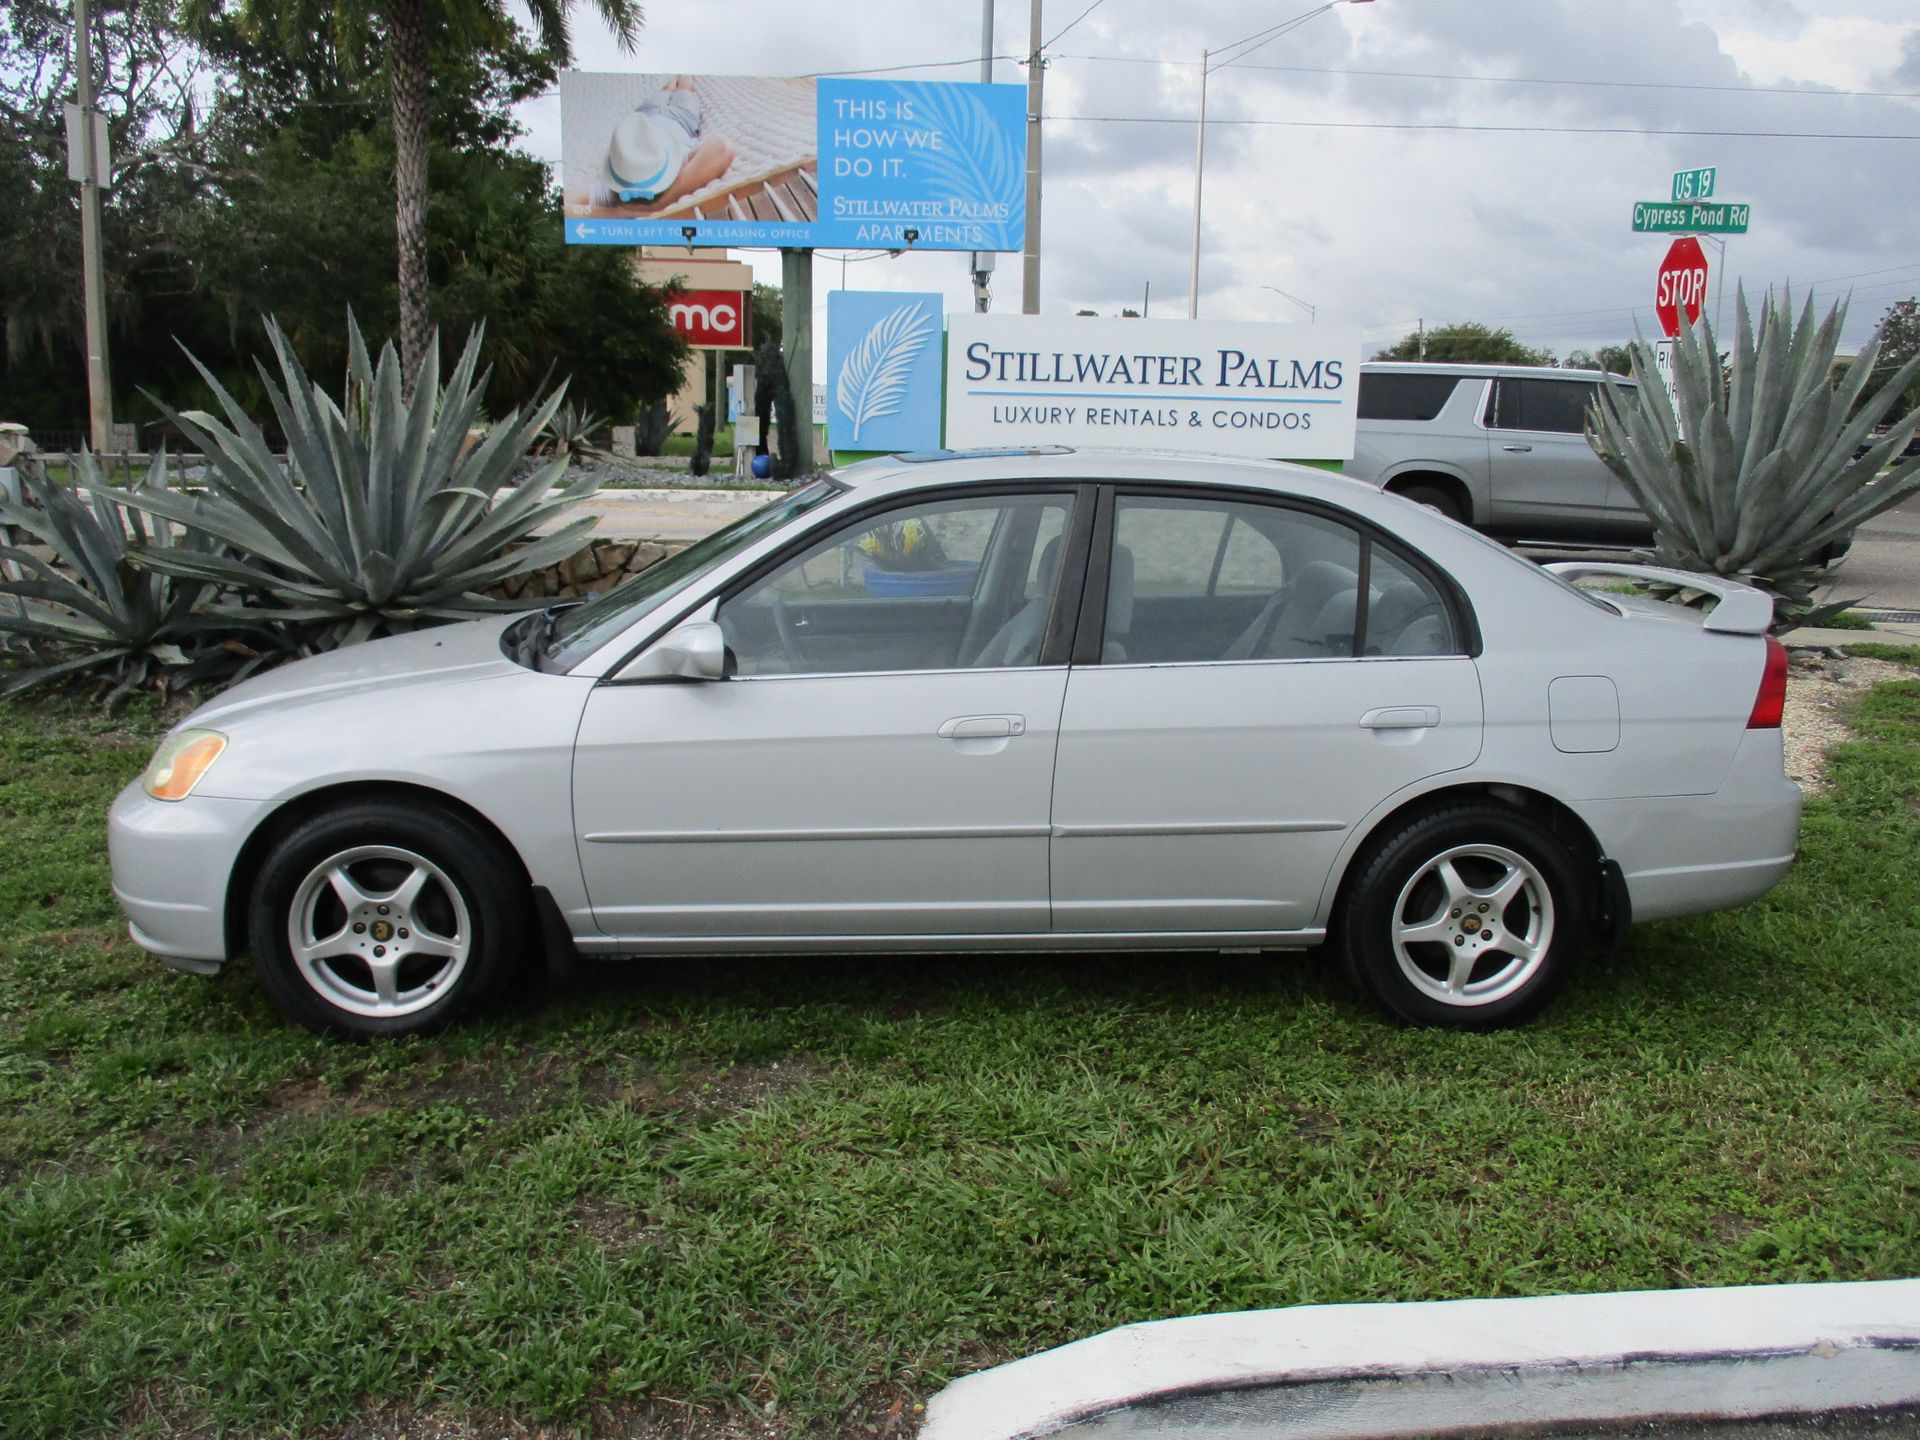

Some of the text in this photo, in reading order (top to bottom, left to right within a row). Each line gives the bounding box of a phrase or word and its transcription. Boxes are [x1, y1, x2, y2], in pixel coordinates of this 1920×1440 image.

[833, 98, 914, 120] THIS IS
[834, 128, 943, 151] HOW WE
[834, 156, 907, 178] DO IT.
[1675, 170, 1711, 199] US 19
[833, 195, 1009, 218] STILLWATER PALMS
[1634, 203, 1748, 230] Cypress Pond Rd
[600, 226, 633, 237] TURN
[638, 226, 663, 237] LEFT
[667, 227, 683, 237] TO
[717, 227, 766, 239] LEASING
[770, 228, 812, 240] OFFICE
[1659, 268, 1704, 307] STOP
[966, 342, 1343, 390] STILLWATER PALMS
[993, 406, 1312, 430] LUXURY RENTALS & CONDOS
